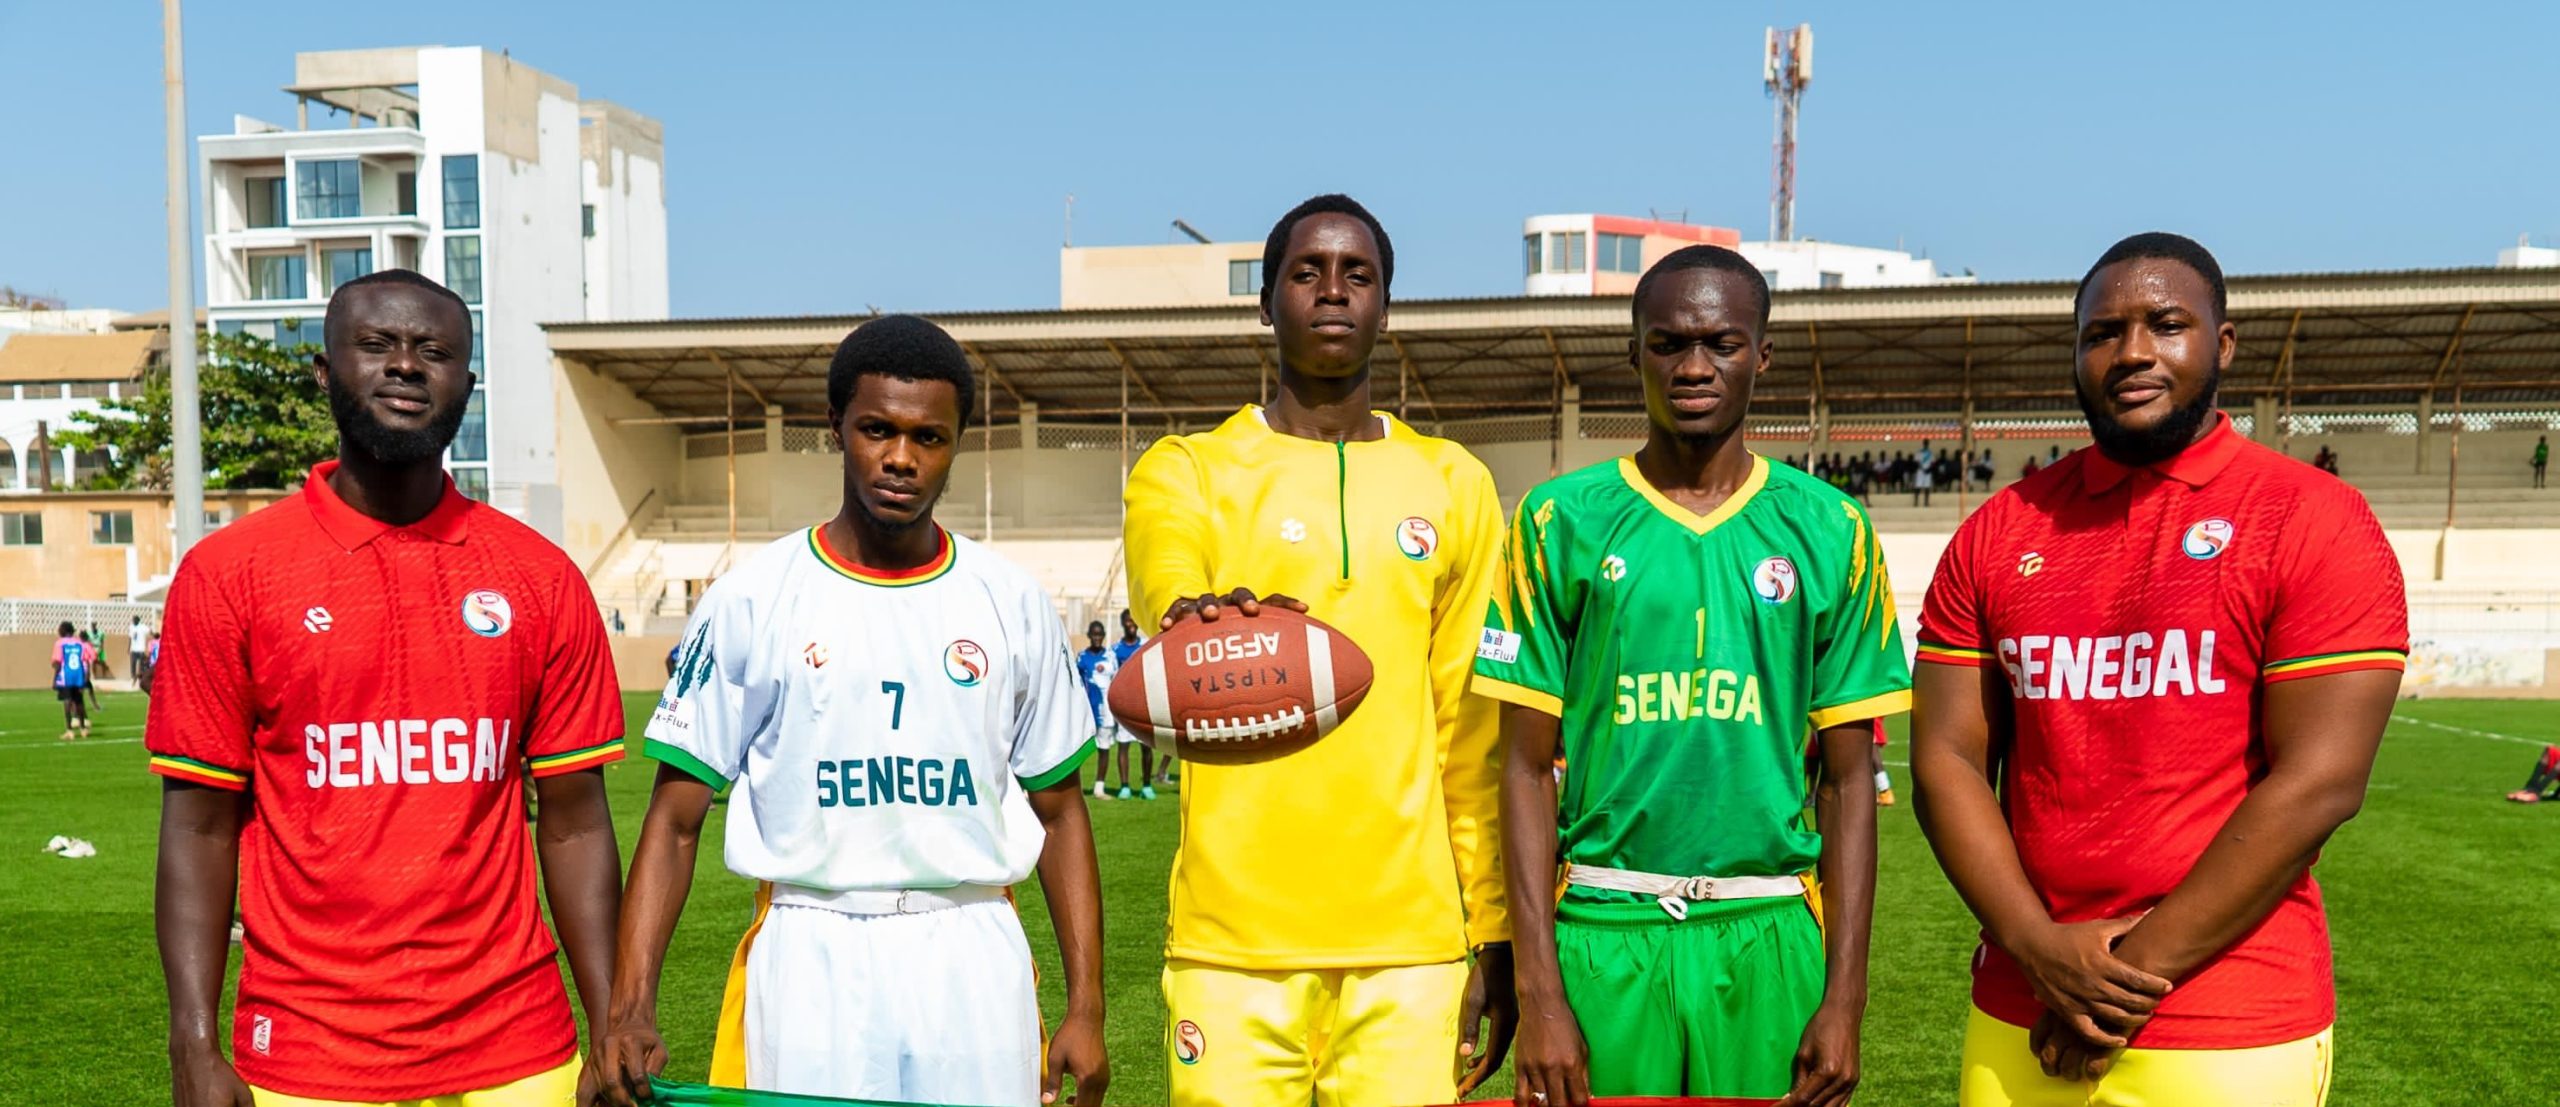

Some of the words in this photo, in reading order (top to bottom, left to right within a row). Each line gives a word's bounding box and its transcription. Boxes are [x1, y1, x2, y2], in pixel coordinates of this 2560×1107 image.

[1185, 631, 1280, 667] AF500
[1695, 607, 1705, 659] 1
[1190, 667, 1287, 694] KIPSTA
[1998, 628, 2226, 700] SENEGAL
[881, 681, 905, 730] 7
